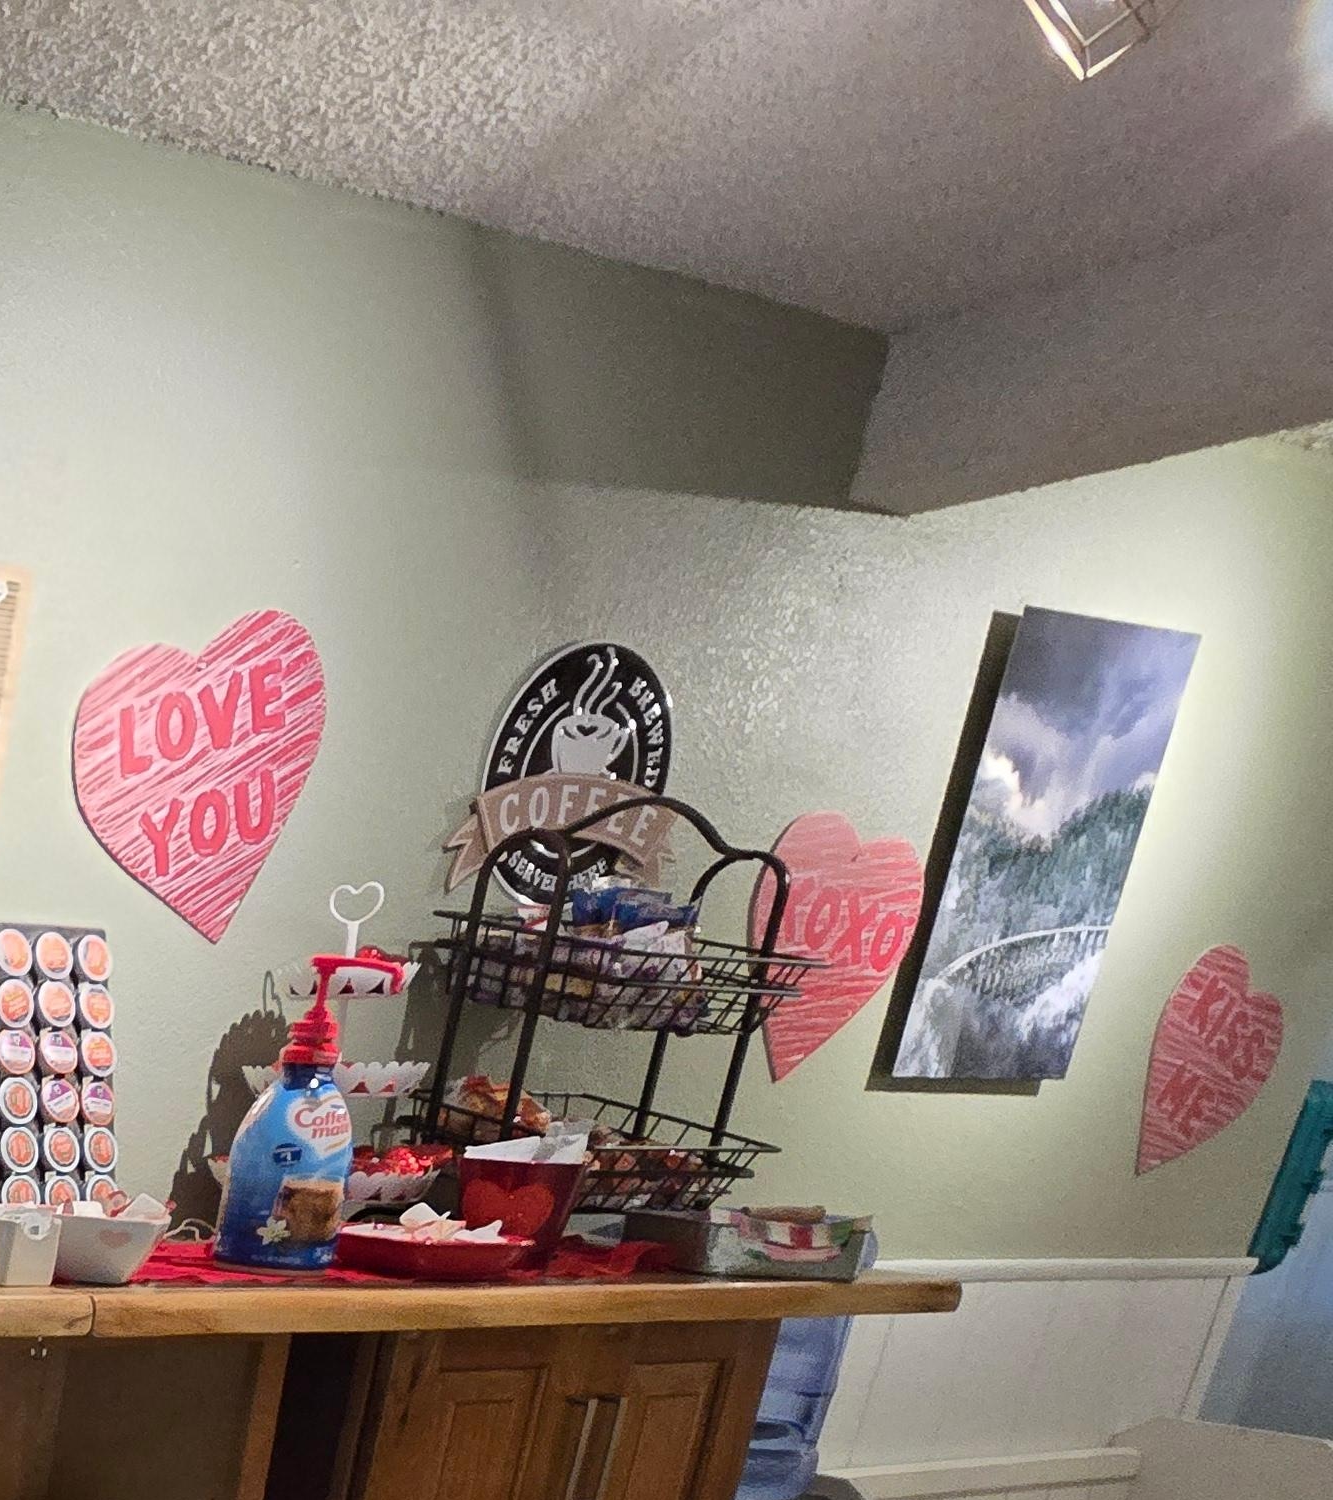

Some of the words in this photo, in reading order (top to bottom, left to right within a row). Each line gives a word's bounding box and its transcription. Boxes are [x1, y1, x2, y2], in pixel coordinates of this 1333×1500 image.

[119, 658, 284, 778] LOVE
[497, 677, 561, 776] FRESH
[628, 676, 666, 789] BREWED
[139, 768, 276, 877] YOU
[498, 784, 658, 847] COFFEE
[1187, 974, 1268, 1082] KISS
